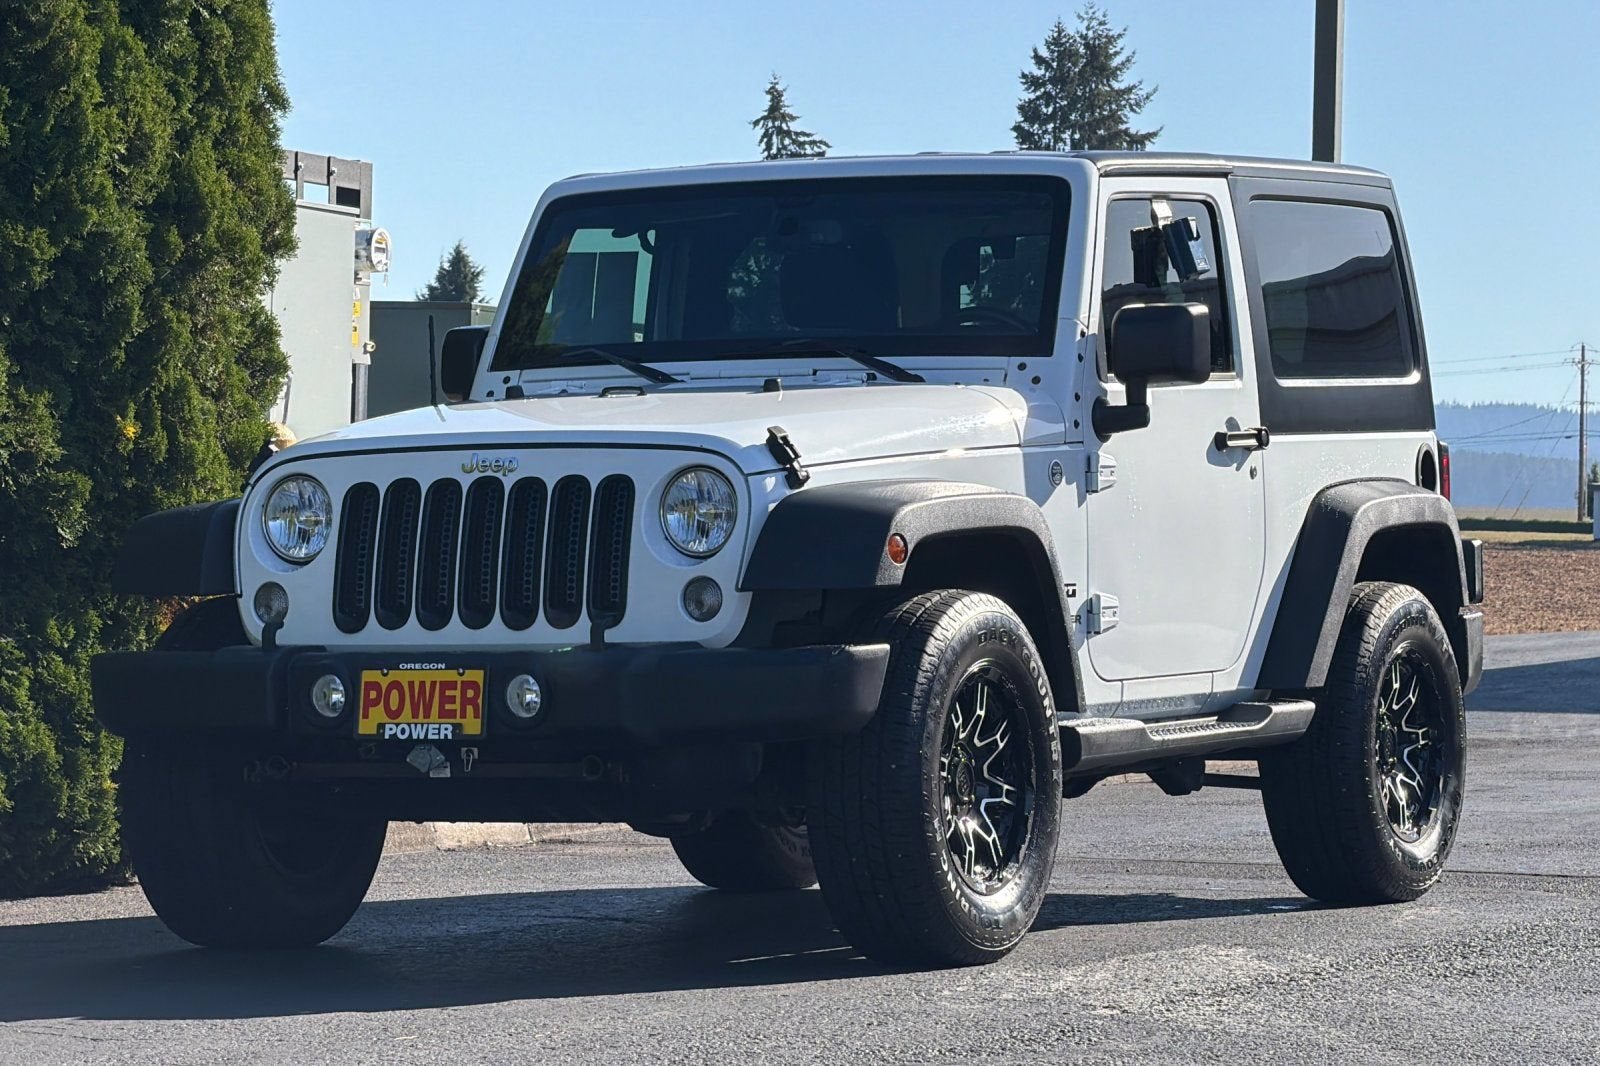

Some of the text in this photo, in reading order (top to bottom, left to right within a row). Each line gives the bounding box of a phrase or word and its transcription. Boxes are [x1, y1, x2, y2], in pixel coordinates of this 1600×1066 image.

[461, 452, 519, 477] Jeep
[361, 680, 481, 720] POWER
[384, 724, 453, 740] POWER
